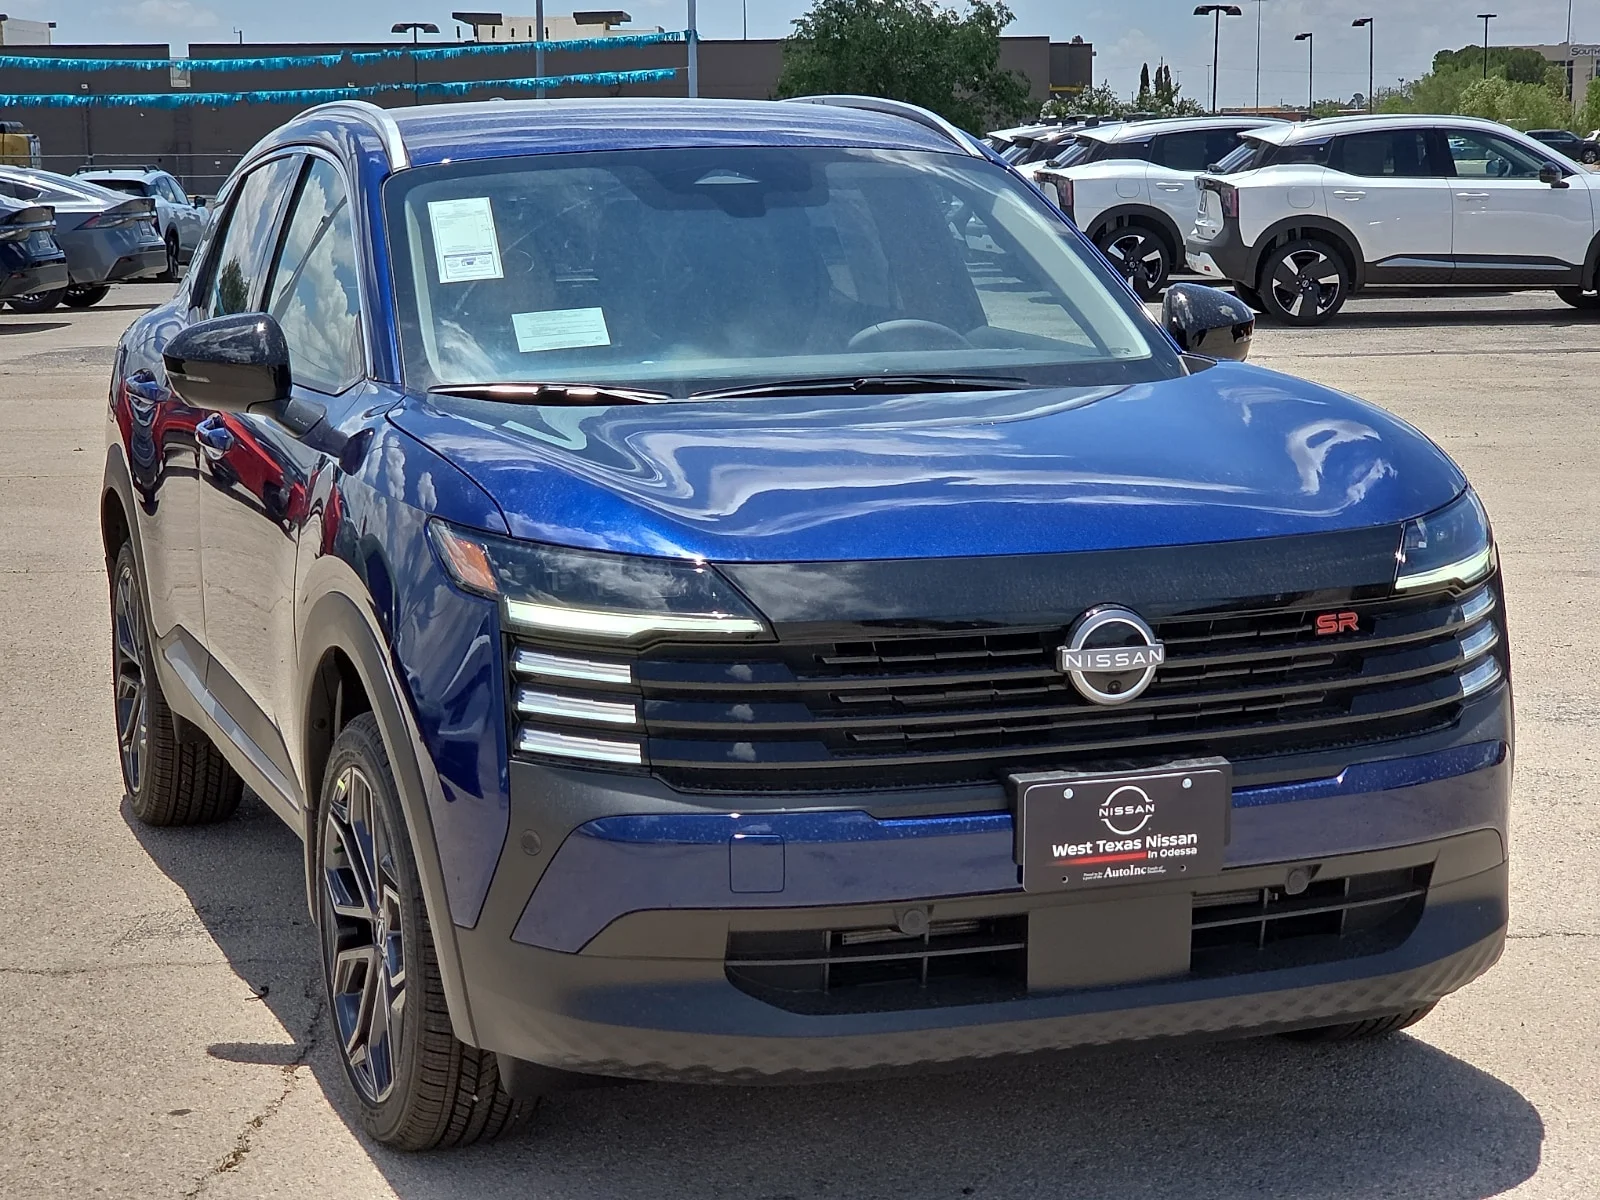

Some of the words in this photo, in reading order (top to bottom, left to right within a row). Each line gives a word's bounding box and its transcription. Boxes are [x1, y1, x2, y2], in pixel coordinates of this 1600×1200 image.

[1317, 612, 1360, 635] SR
[1065, 648, 1162, 668] NISSAN
[1099, 804, 1155, 817] NISSAN
[1052, 841, 1093, 857] West
[1096, 838, 1141, 853] Texas
[1145, 833, 1198, 848] Nissan
[1159, 846, 1198, 858] Odessa
[1103, 864, 1147, 878] AutoInc
